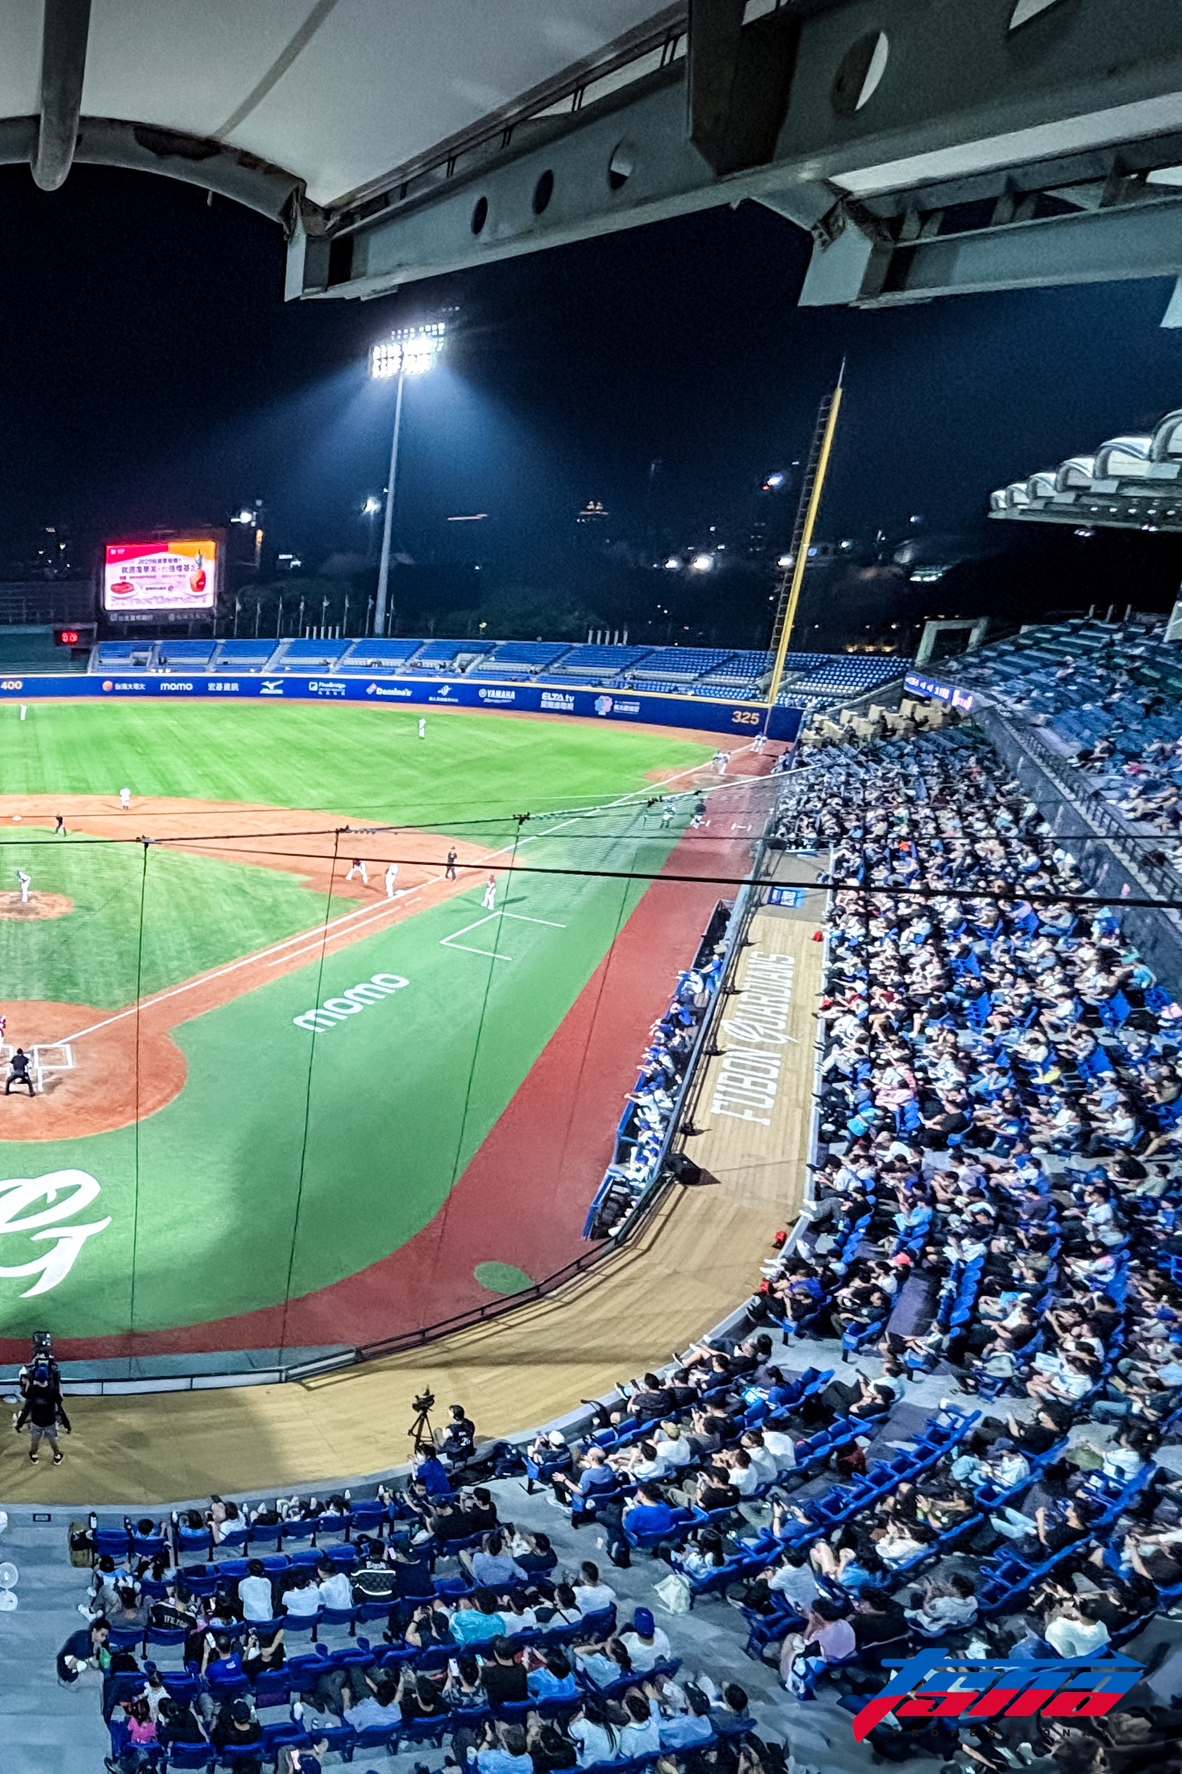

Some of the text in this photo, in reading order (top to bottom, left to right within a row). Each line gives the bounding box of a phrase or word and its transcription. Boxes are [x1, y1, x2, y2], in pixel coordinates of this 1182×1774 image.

[0, 680, 23, 690] 400
[160, 682, 193, 691] momo
[487, 689, 515, 700] YAMAHA
[732, 711, 760, 725] 325
[293, 973, 410, 1033] momo
[710, 951, 799, 1126] FUBON GUARDIANS
